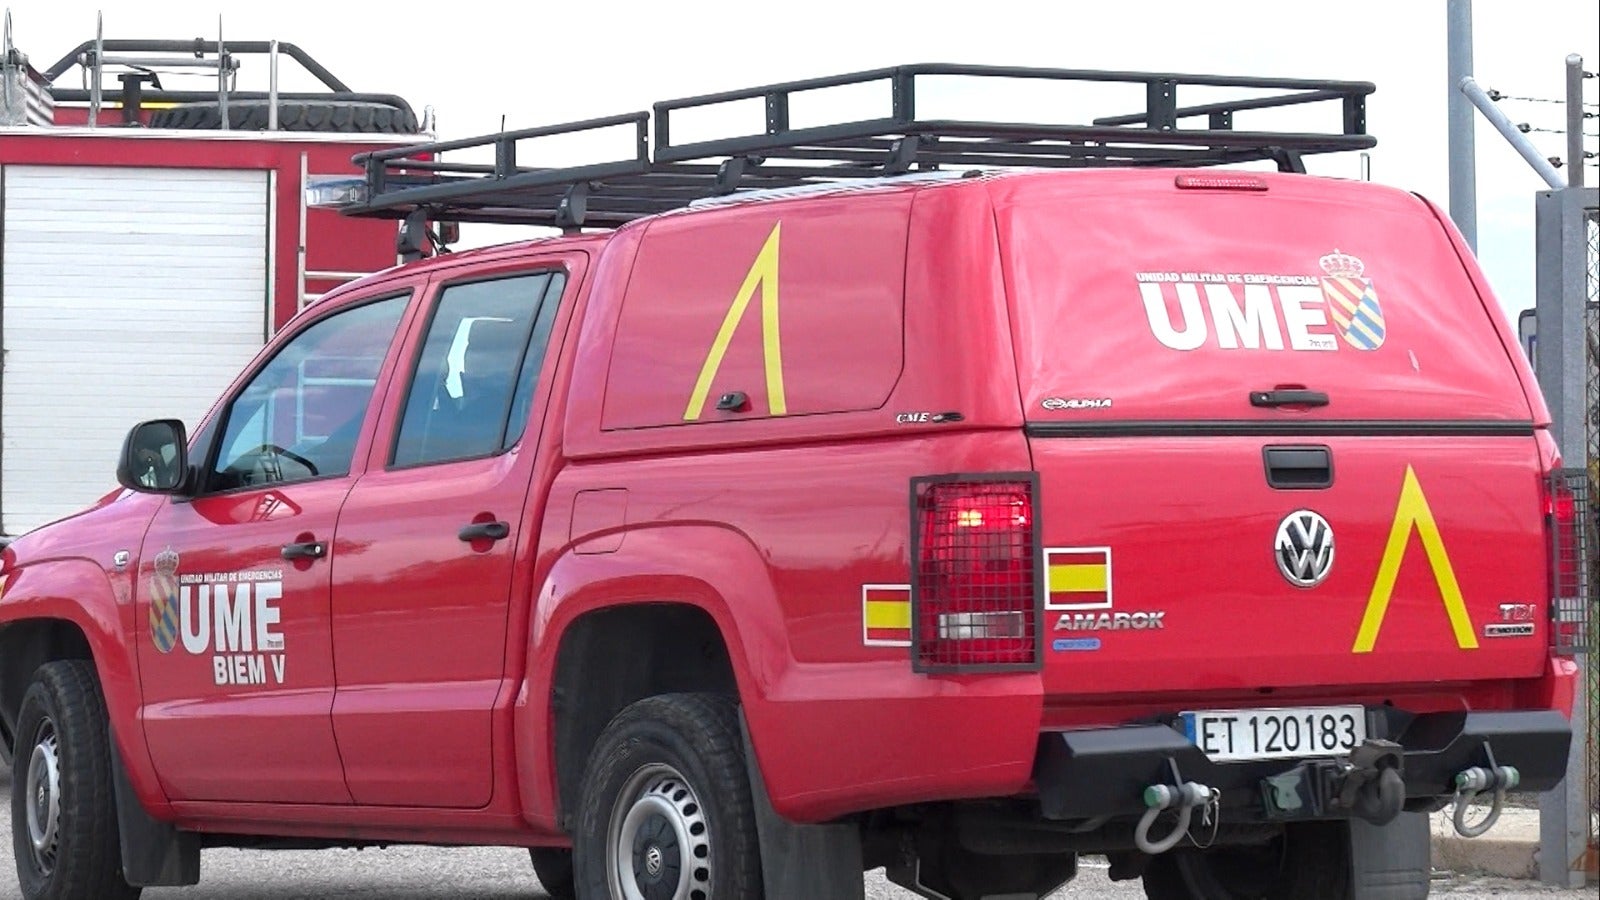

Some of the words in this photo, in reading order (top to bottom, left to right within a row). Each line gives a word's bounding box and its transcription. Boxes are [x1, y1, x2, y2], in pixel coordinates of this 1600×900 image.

[1136, 272, 1179, 283] UNIDAD
[1181, 273, 1226, 284] MILITAR
[1227, 274, 1242, 284] DE
[1244, 274, 1320, 286] EMERGENCIAS
[1138, 283, 1339, 351] UME
[180, 573, 203, 584] UNIDAD
[204, 572, 228, 583] MILITAR
[229, 571, 238, 582] DE
[238, 569, 283, 582] EMERGENCIAS
[180, 582, 285, 654] UME
[1053, 611, 1166, 631] AMAROK
[213, 655, 267, 685] BIEM
[271, 654, 286, 684] V
[1202, 716, 1238, 754] ET
[1248, 714, 1356, 752] 120183
